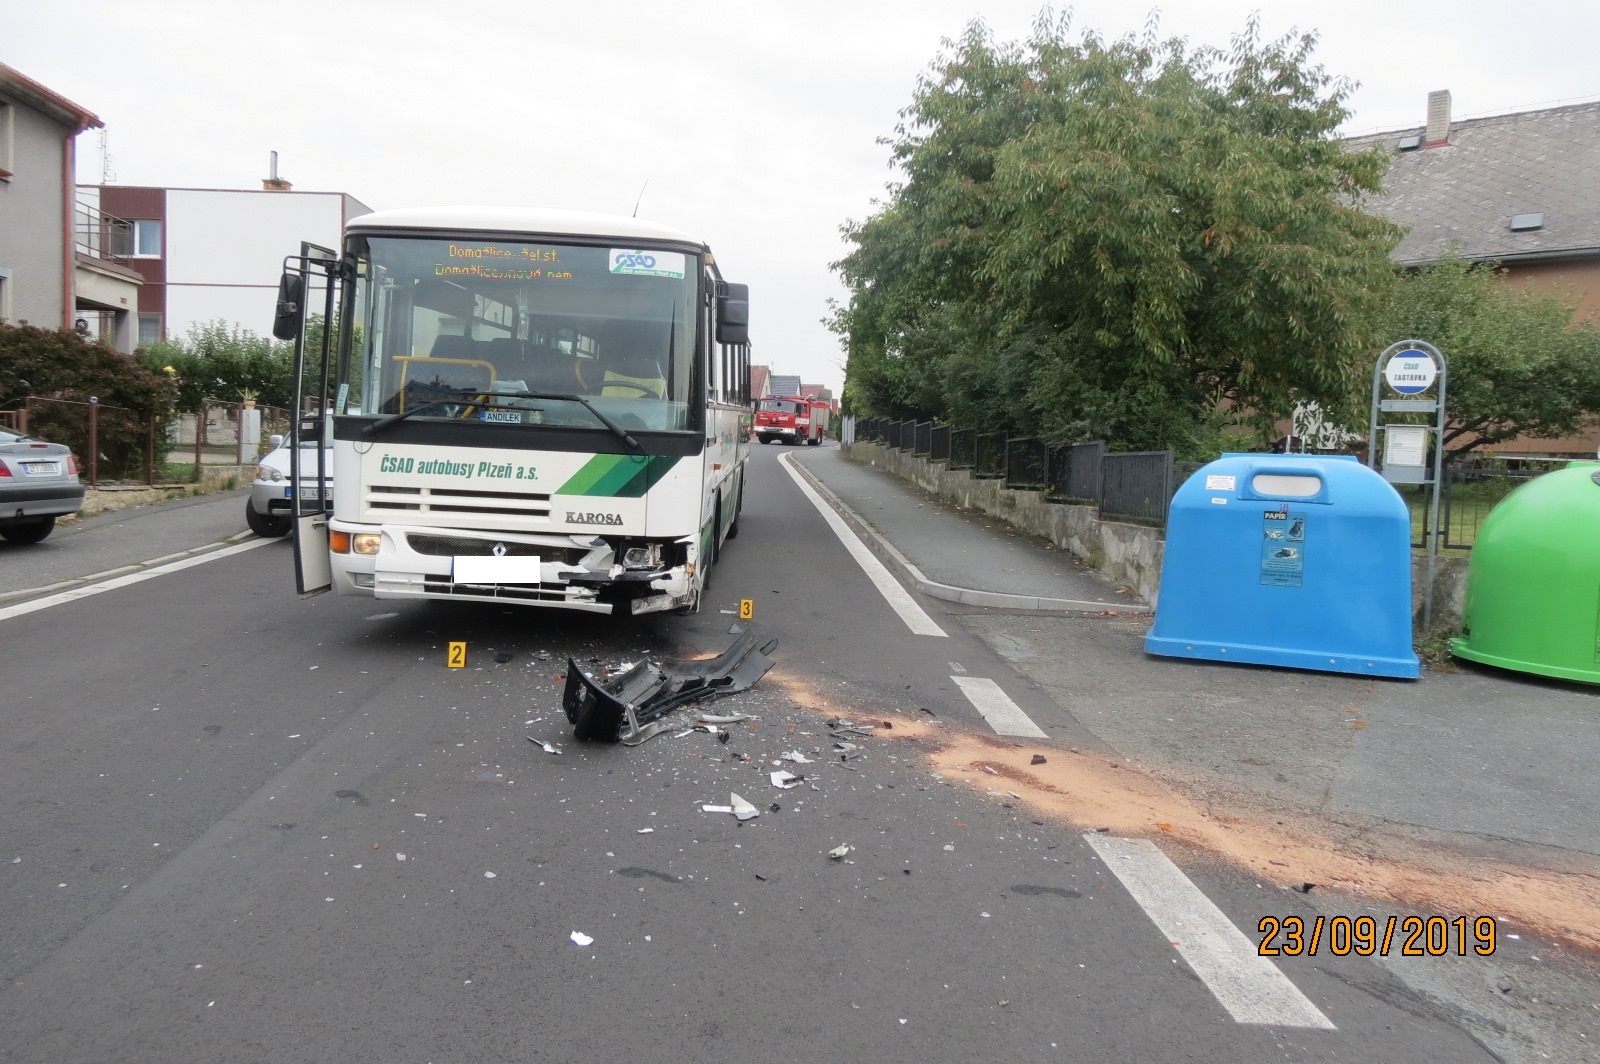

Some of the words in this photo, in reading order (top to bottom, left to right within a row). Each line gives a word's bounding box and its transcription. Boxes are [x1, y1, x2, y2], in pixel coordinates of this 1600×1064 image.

[380, 454, 415, 474] ČSAD
[417, 459, 475, 479] autobusy
[477, 461, 513, 479] Plzeň
[515, 466, 539, 480] a.s.
[565, 512, 624, 526] KAROSA
[743, 601, 751, 616] 3
[451, 645, 462, 665] 2
